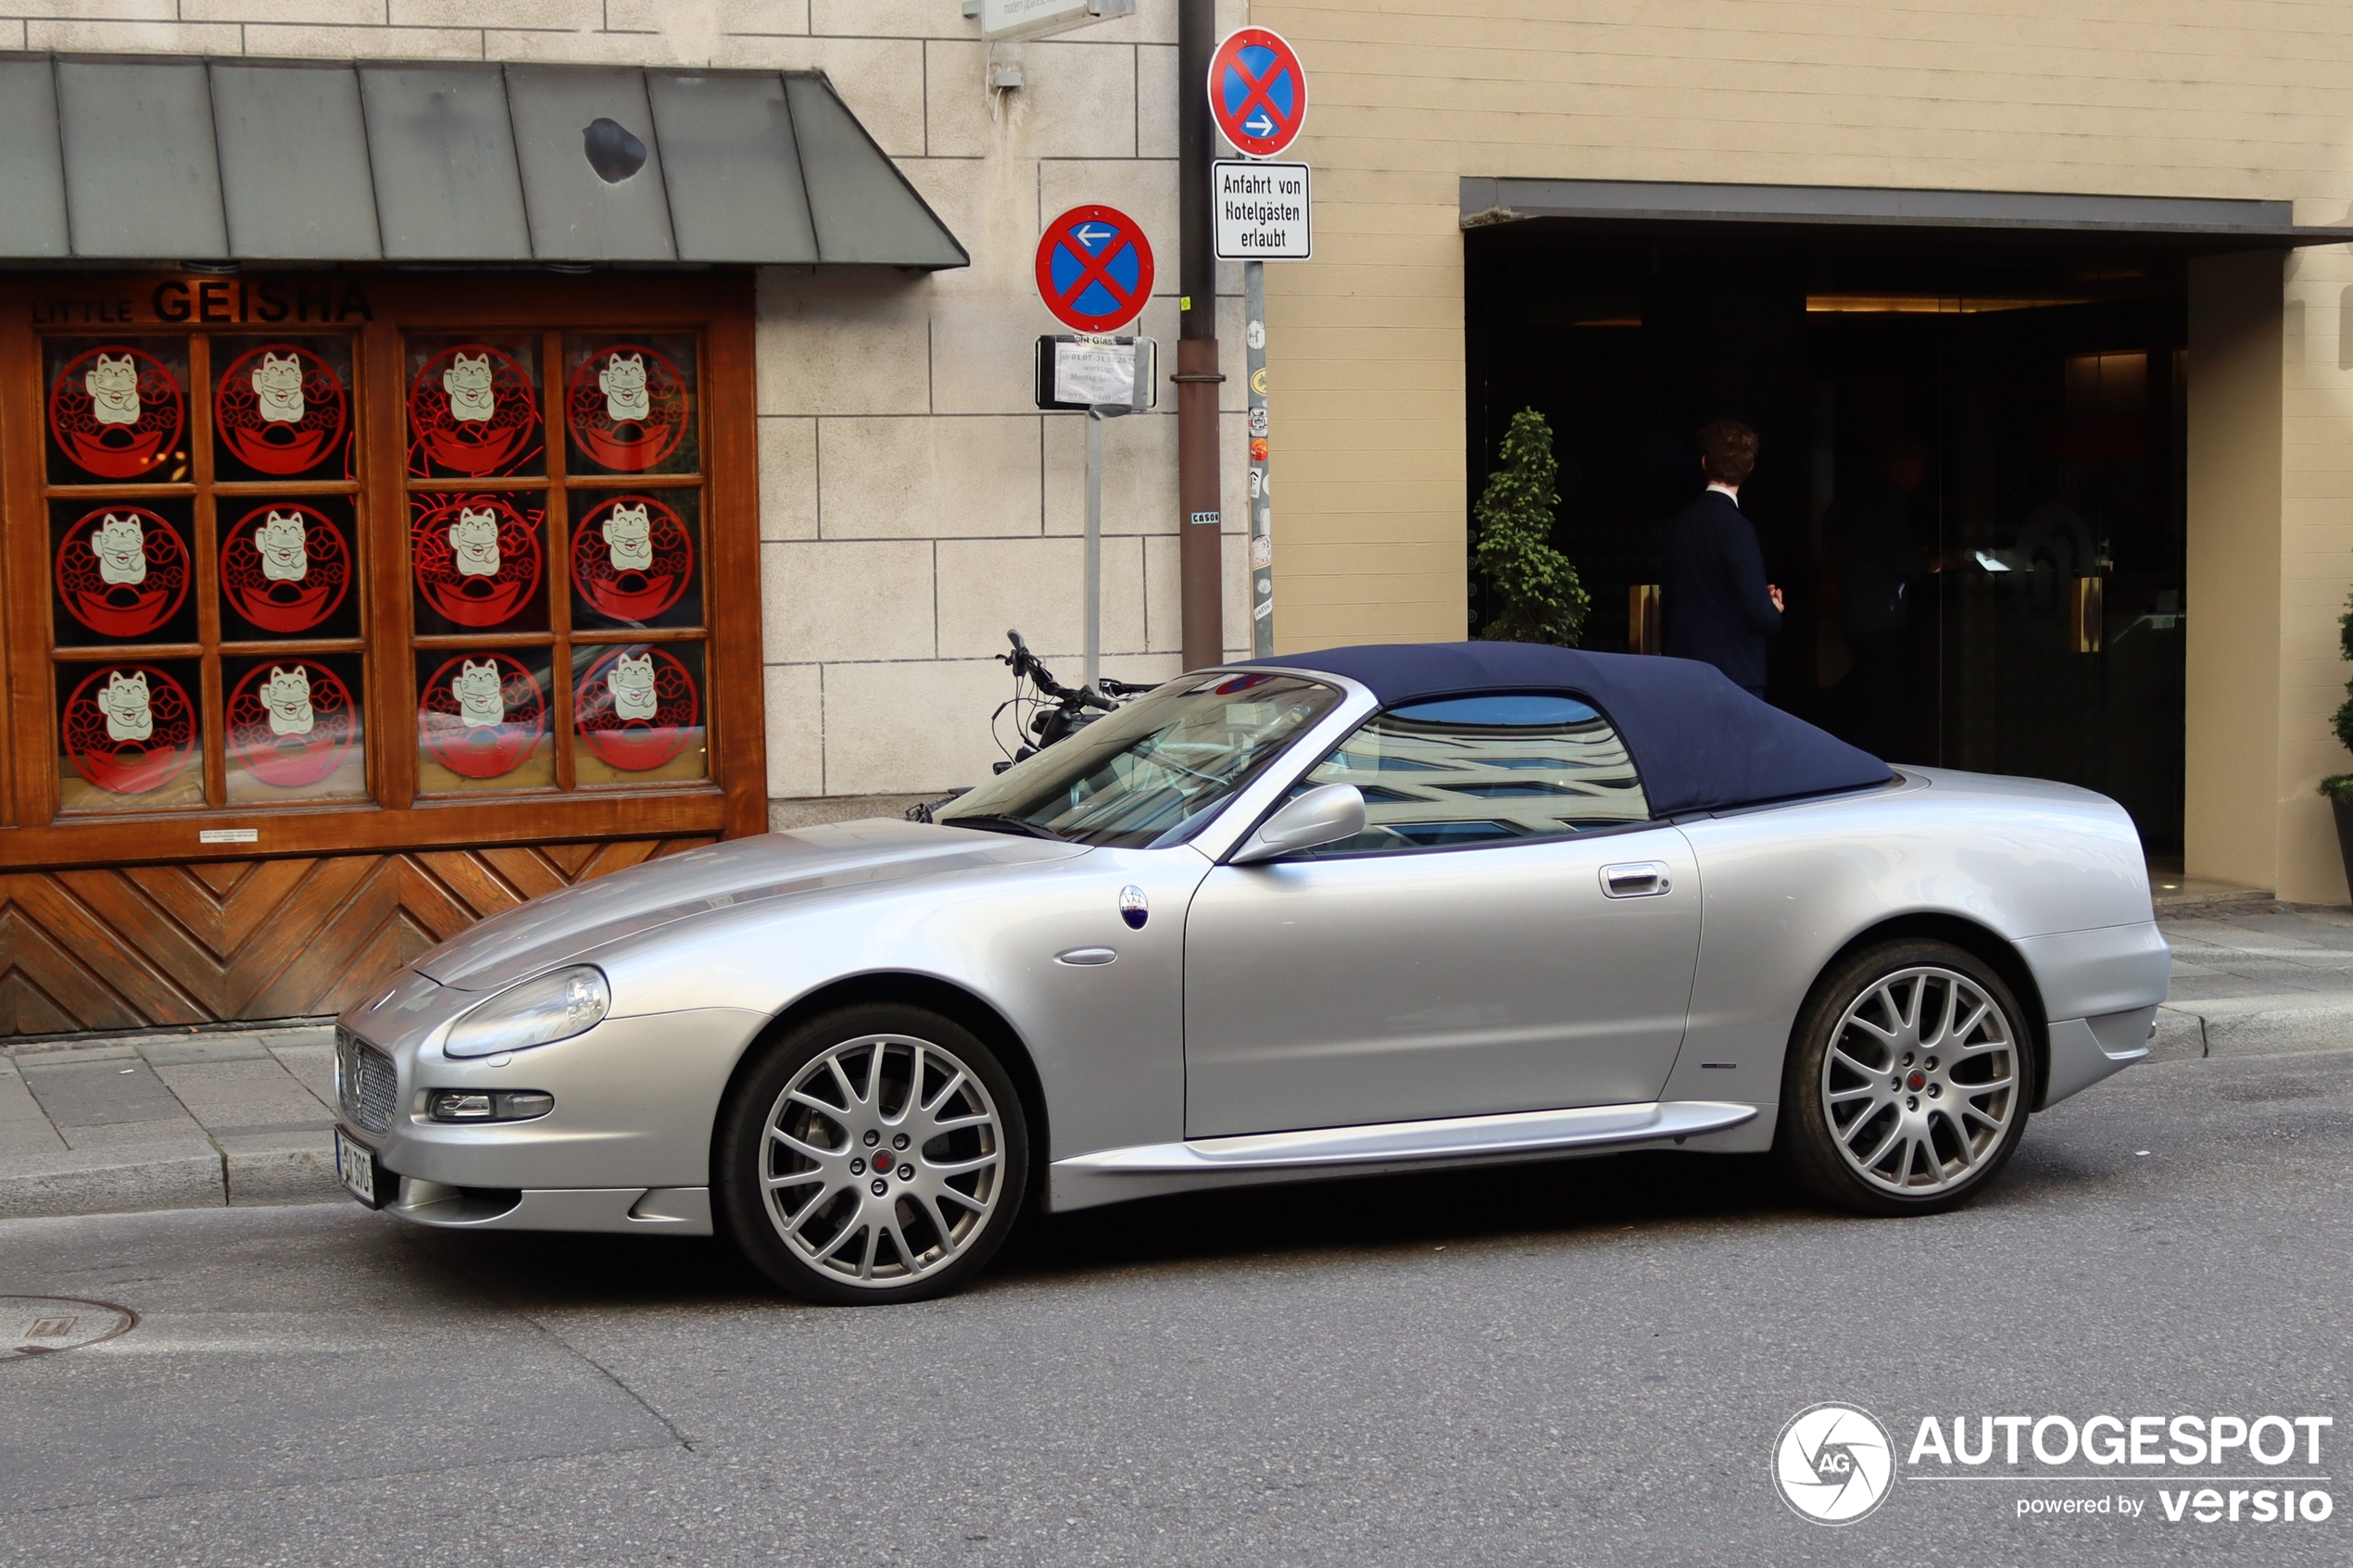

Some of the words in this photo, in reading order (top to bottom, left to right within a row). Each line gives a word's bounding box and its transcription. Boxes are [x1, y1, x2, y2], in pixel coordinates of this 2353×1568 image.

[1224, 174, 1272, 194] Anfahrt
[1278, 181, 1301, 194] von
[1226, 201, 1300, 225] Hotelgästen
[1241, 228, 1286, 247] erlaubt
[31, 299, 133, 323] LITTLE
[152, 281, 373, 323] GEISHA
[1083, 365, 1114, 374] werktags
